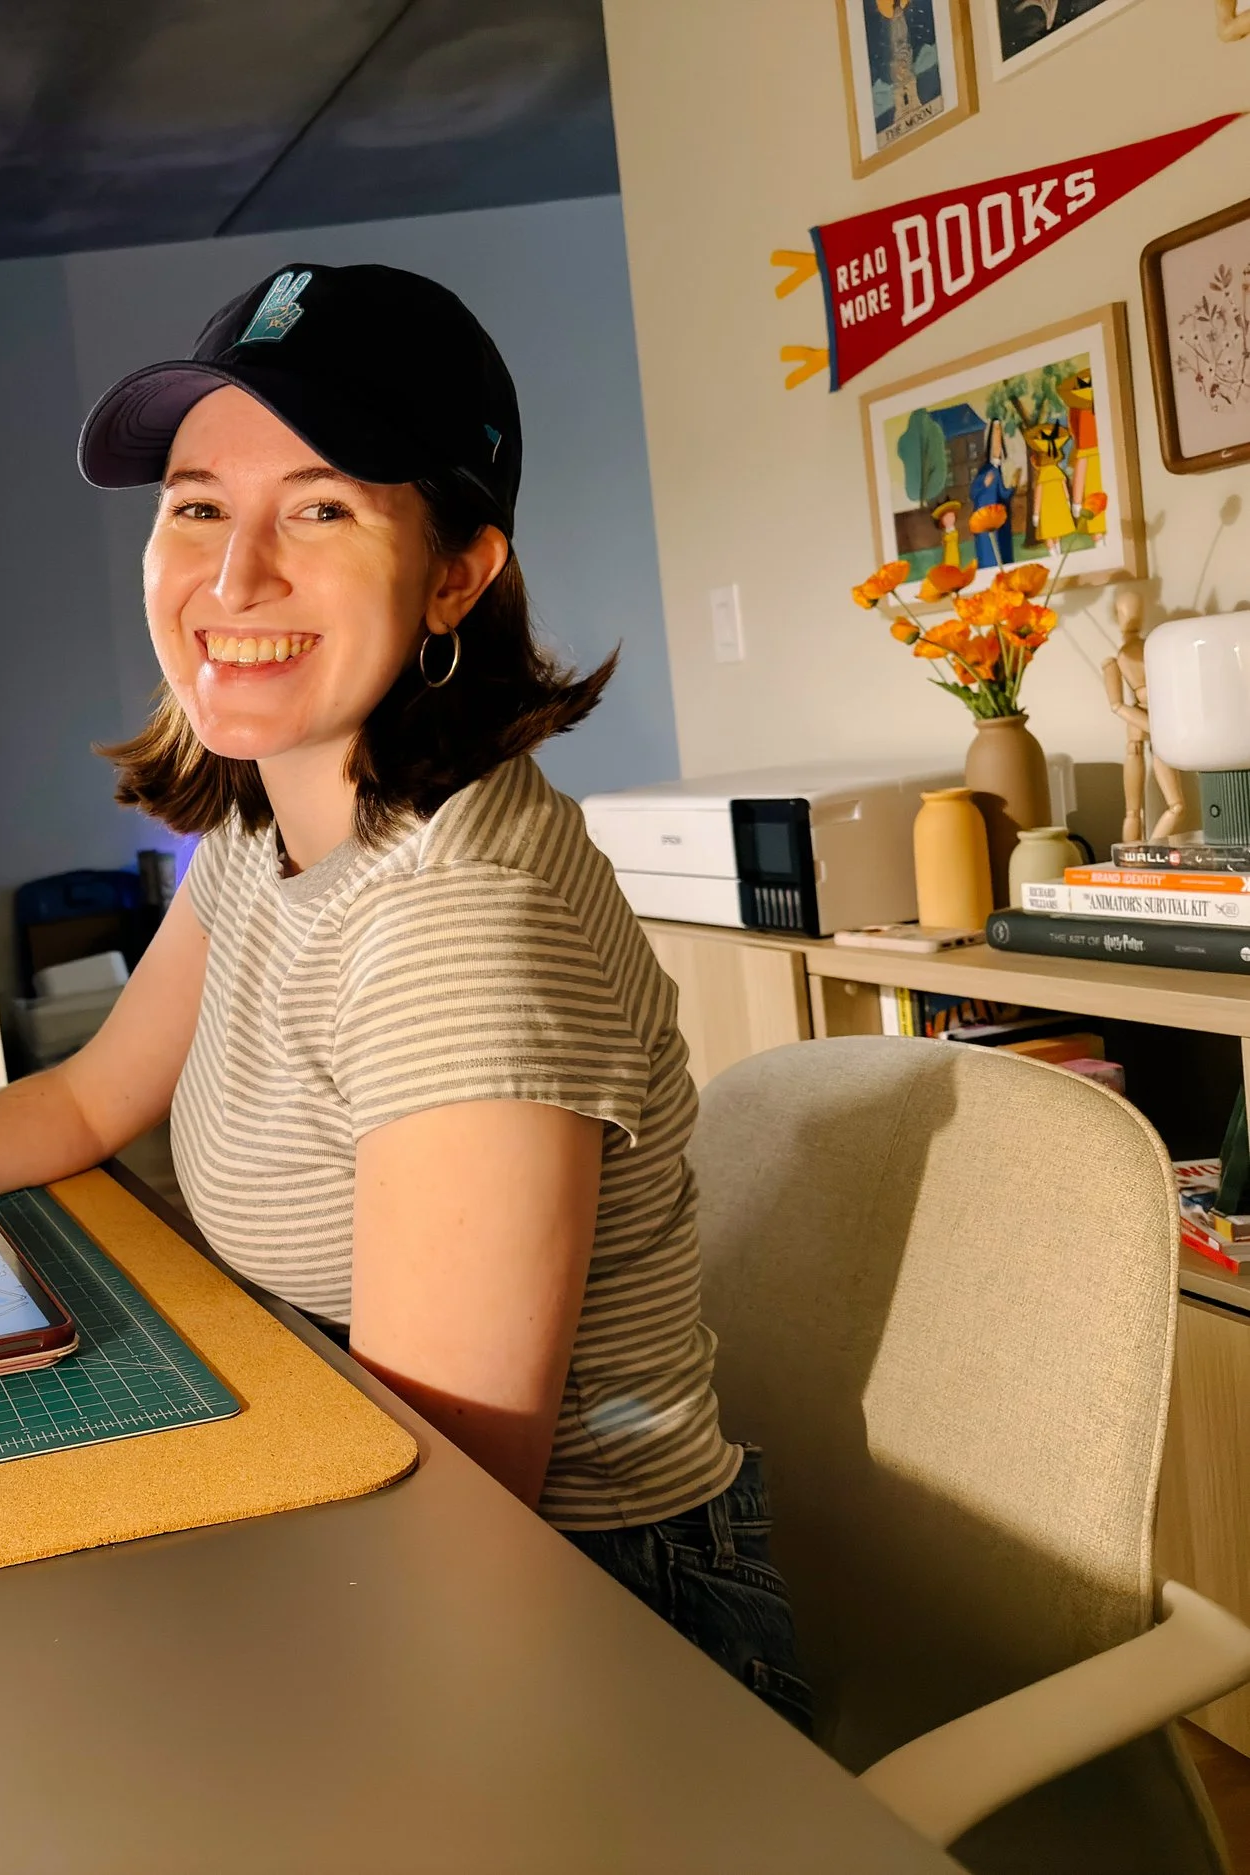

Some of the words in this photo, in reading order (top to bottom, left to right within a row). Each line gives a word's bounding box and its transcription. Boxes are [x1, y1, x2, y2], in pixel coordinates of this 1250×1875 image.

[891, 168, 1096, 327] BOOKS
[835, 245, 888, 293] READ
[839, 282, 891, 329] MORE
[1091, 872, 1121, 884] BRAND
[1122, 873, 1163, 886] IDENTITY
[1029, 887, 1057, 898] RICHARD
[1029, 899, 1058, 910] WILLIAMS
[1090, 894, 1143, 912] ANIMATOR'S
[1144, 897, 1190, 915] SURVIVAL
[1190, 900, 1209, 917] KIT
[1050, 933, 1067, 945] THE
[1069, 935, 1086, 946] ART
[1087, 936, 1100, 946] OF
[1103, 934, 1123, 953] Harry
